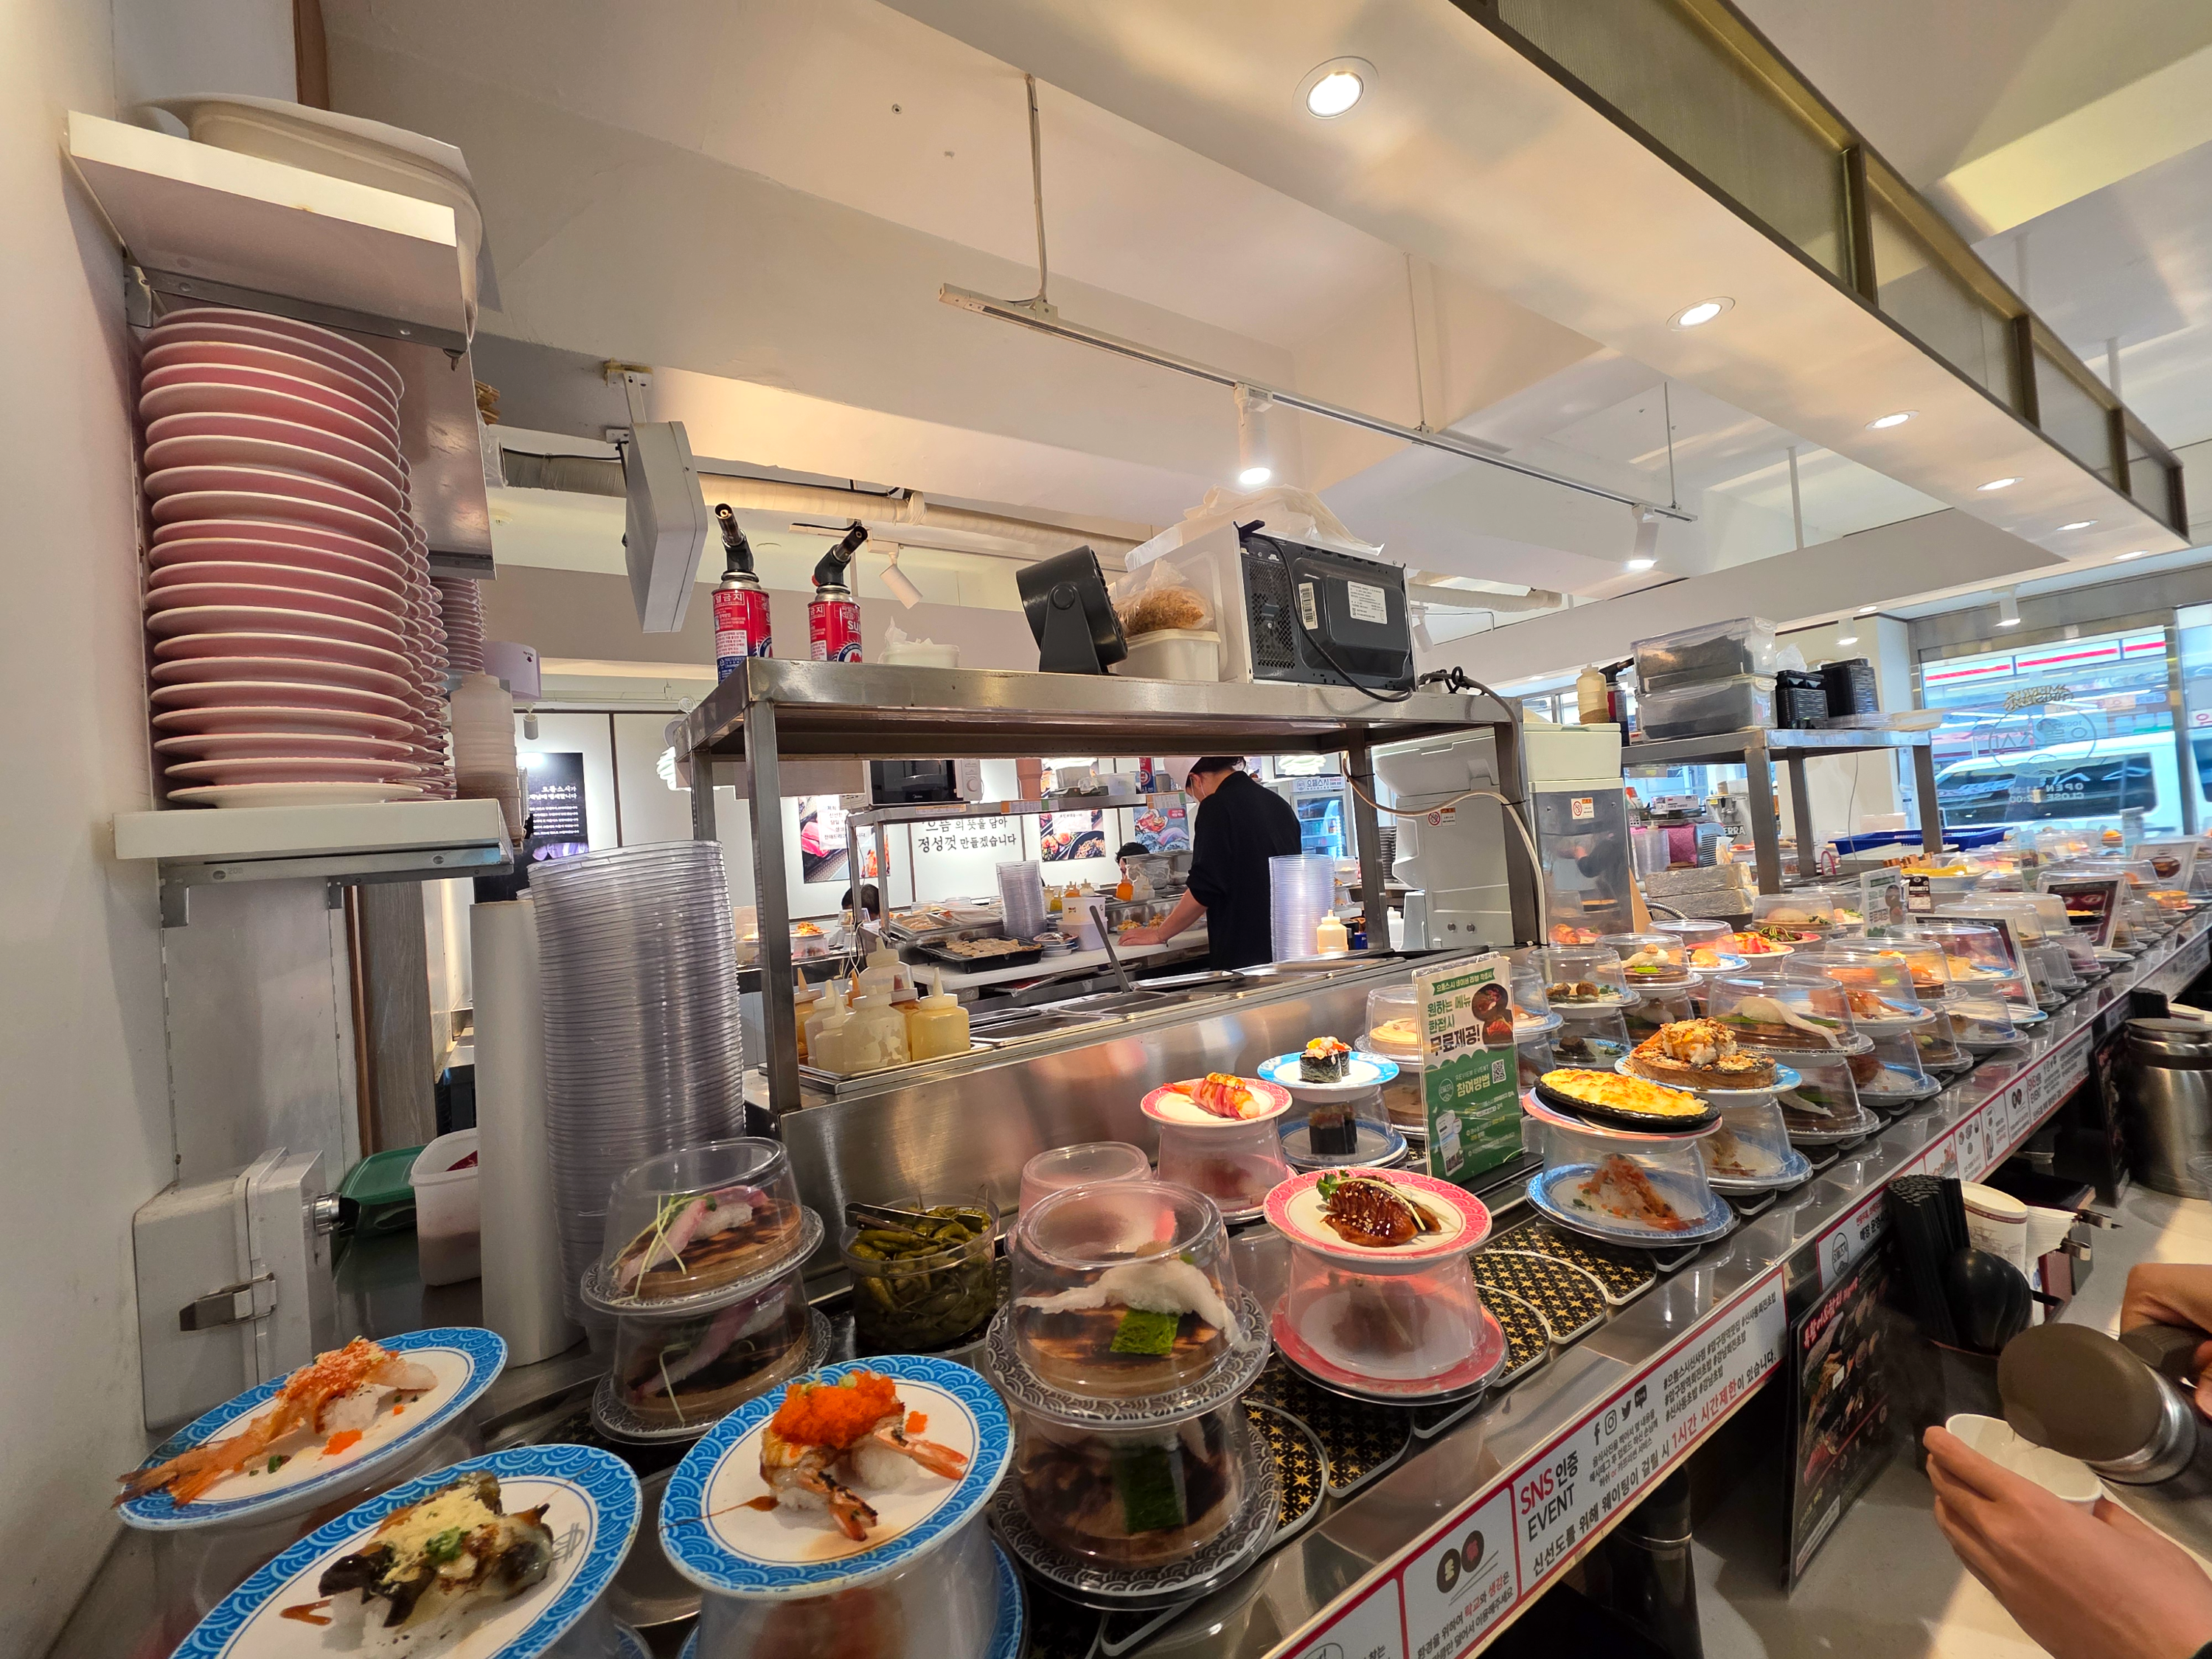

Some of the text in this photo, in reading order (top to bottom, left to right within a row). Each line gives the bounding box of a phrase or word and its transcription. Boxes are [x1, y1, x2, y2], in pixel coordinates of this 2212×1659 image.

[714, 593, 742, 603] 열금지
[989, 816, 1008, 829] 담아
[1724, 826, 1746, 835] ERRA
[918, 833, 1017, 853] 정성껏 만들겠습니다
[1436, 970, 1492, 992] 으뜸스시 네이버 리뷰 작성시
[1427, 994, 1471, 1018] 원하는 메뉴
[1428, 1014, 1455, 1034] 한접시
[1430, 1024, 1481, 1057] 무료제공!
[1455, 1064, 1489, 1082] REVIEW EVENT
[1456, 1073, 1491, 1098] 참여방법
[1860, 1222, 1871, 1241] 매장
[1663, 1347, 1706, 1390] #으뜸스시신사점
[1742, 1291, 1776, 1328] #신사동회전초밥
[1665, 1330, 1746, 1406] #압구정역회전초밥 #강남회전초밥
[1666, 1365, 1723, 1423] #신사동초밥 #강남초밥
[1589, 1418, 1658, 1482] 해시태그 후 업로드 하신 손님께
[1593, 1439, 1618, 1469] 음식사진을
[1618, 1425, 1634, 1444] 찍어서
[1640, 1408, 1655, 1427] 내용을
[1533, 1349, 1776, 1577] 신선도를 위해 웨이팅이 걸릴 시 1시간 시간제한이 있습니다.
[1611, 1470, 1618, 1478] or
[1638, 1437, 1652, 1454] 서비스
[1520, 1450, 1579, 1515] SNS 인증
[1528, 1482, 1575, 1543] EVENT
[1417, 1571, 1509, 1659] 환경을 위하여 락교와 생강은
[1454, 1620, 1475, 1648] 덜어서
[1475, 1587, 1513, 1627] 이용해주세요
